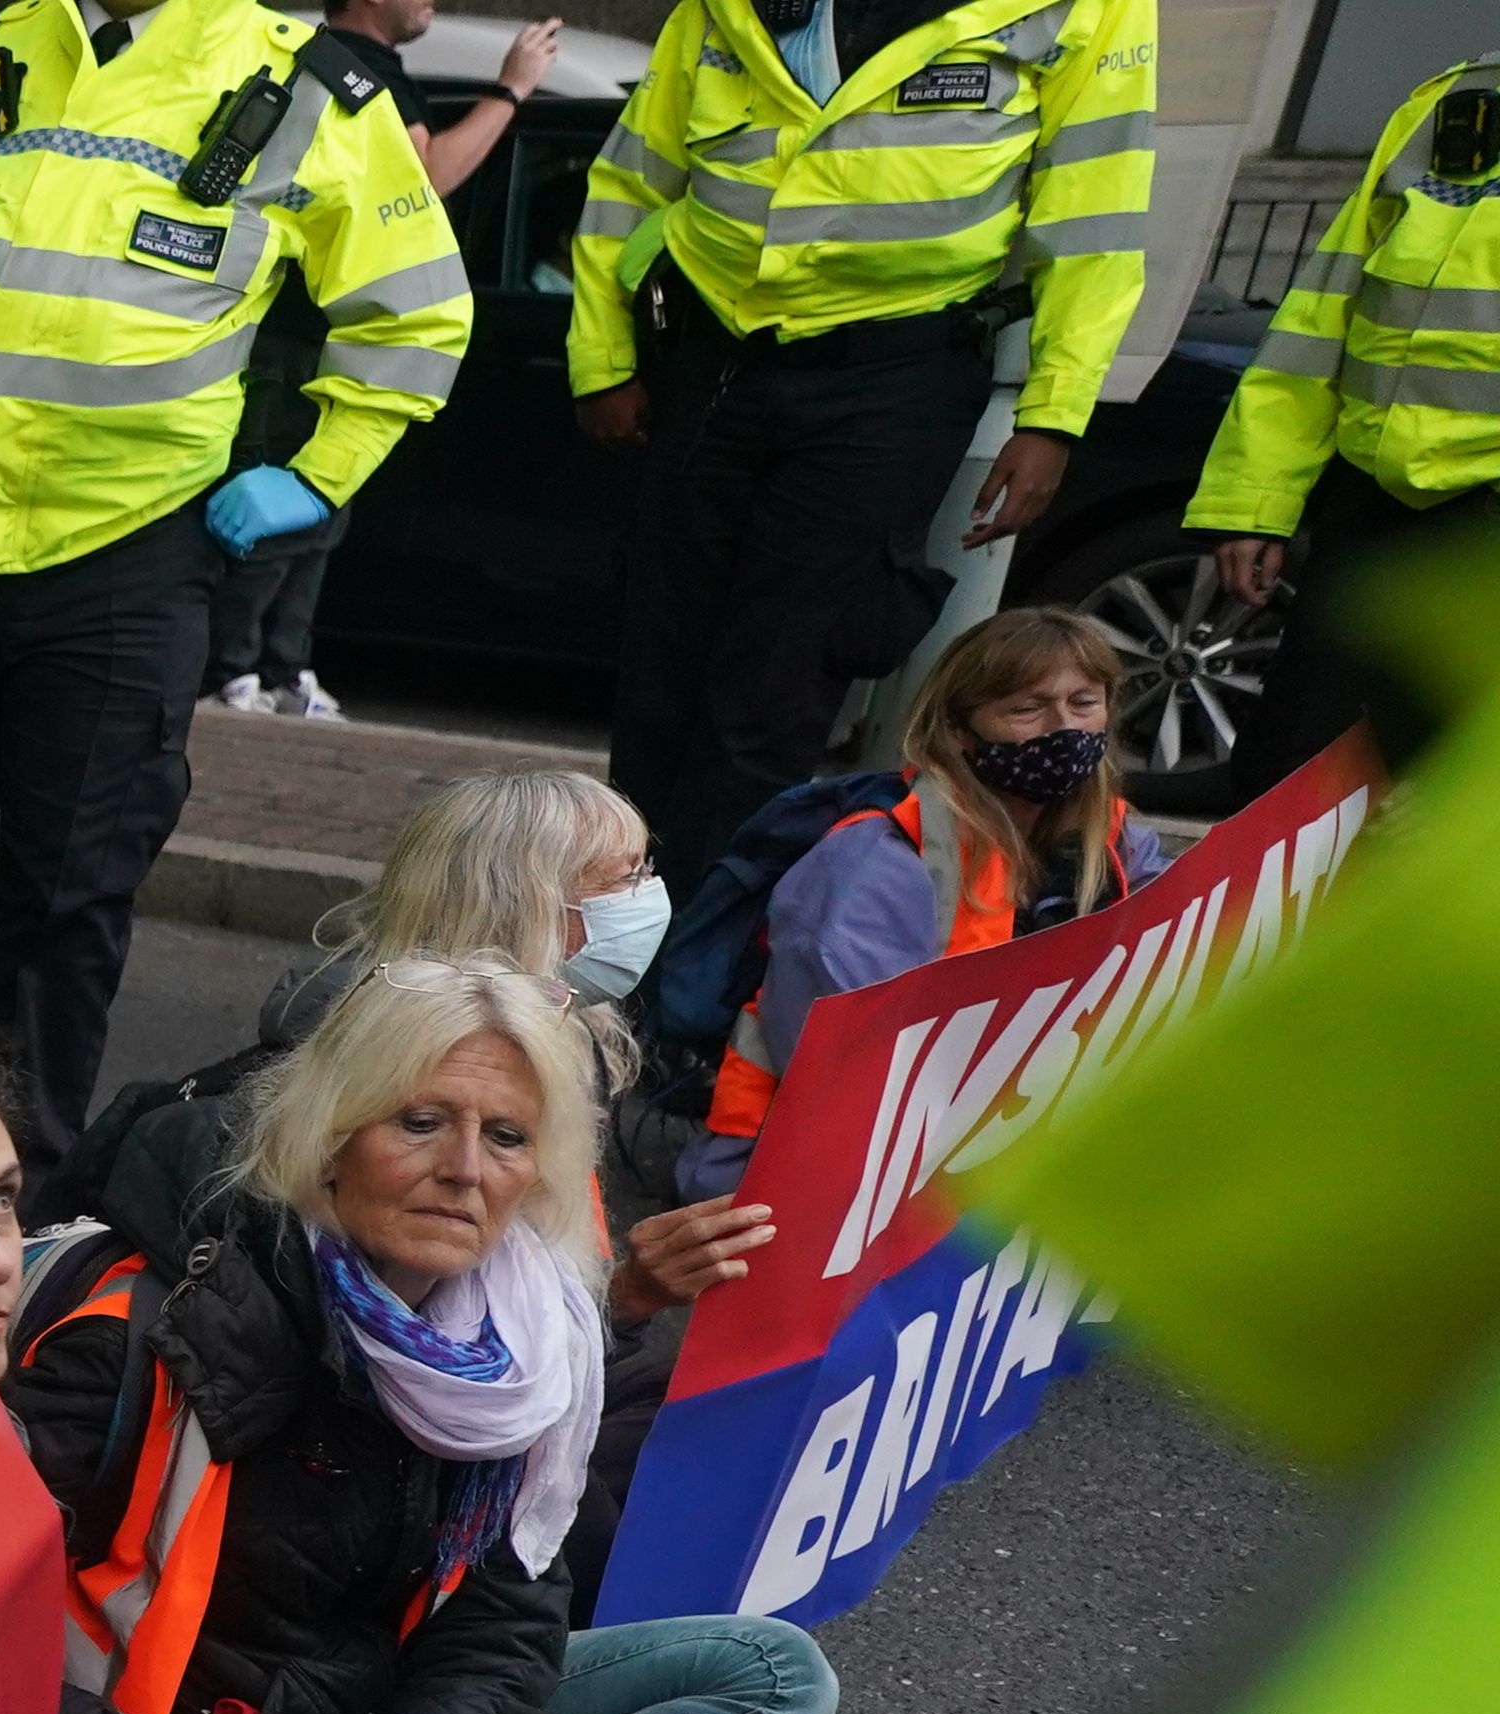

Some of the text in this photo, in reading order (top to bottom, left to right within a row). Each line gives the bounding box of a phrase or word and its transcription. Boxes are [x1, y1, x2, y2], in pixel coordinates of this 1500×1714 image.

[937, 77, 977, 85] POLICE
[904, 88, 984, 100] POLICE OFFICER
[170, 233, 205, 249] POLICE
[136, 237, 214, 265] POLICE OFFICER
